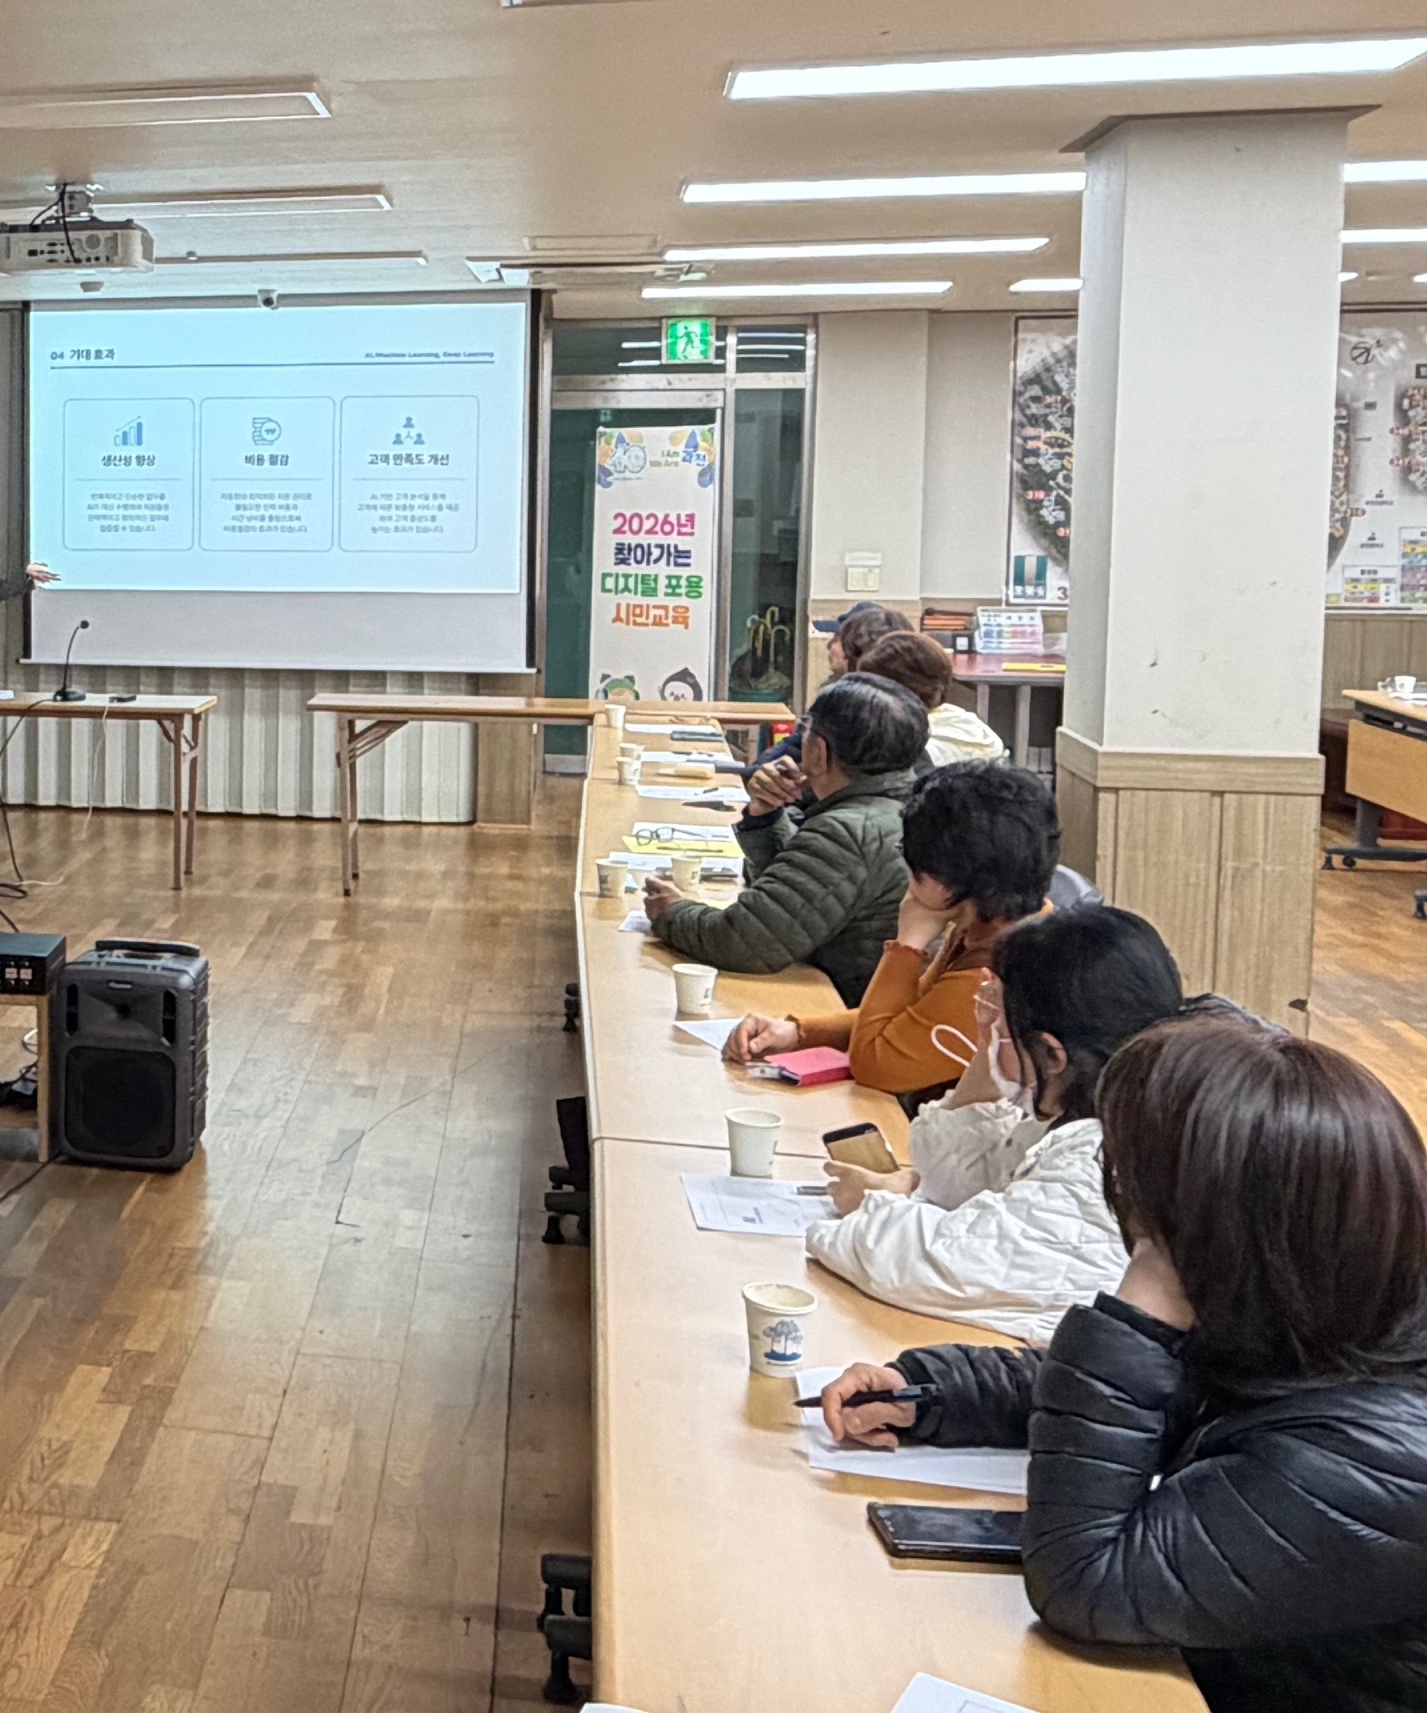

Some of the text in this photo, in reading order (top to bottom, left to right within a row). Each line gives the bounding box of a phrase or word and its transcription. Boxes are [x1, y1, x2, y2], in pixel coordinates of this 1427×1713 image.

[50, 349, 115, 360] 04 기대 효과
[101, 454, 156, 466] 생산성 향상
[245, 454, 289, 466] 비용 절감
[368, 453, 450, 466] 고객 만족도 개선
[681, 449, 707, 467] 과천
[612, 512, 696, 537] 2026년
[613, 542, 692, 567] 찾아가는
[600, 572, 704, 599] 디지털 포용
[611, 602, 690, 630] 시민교육
